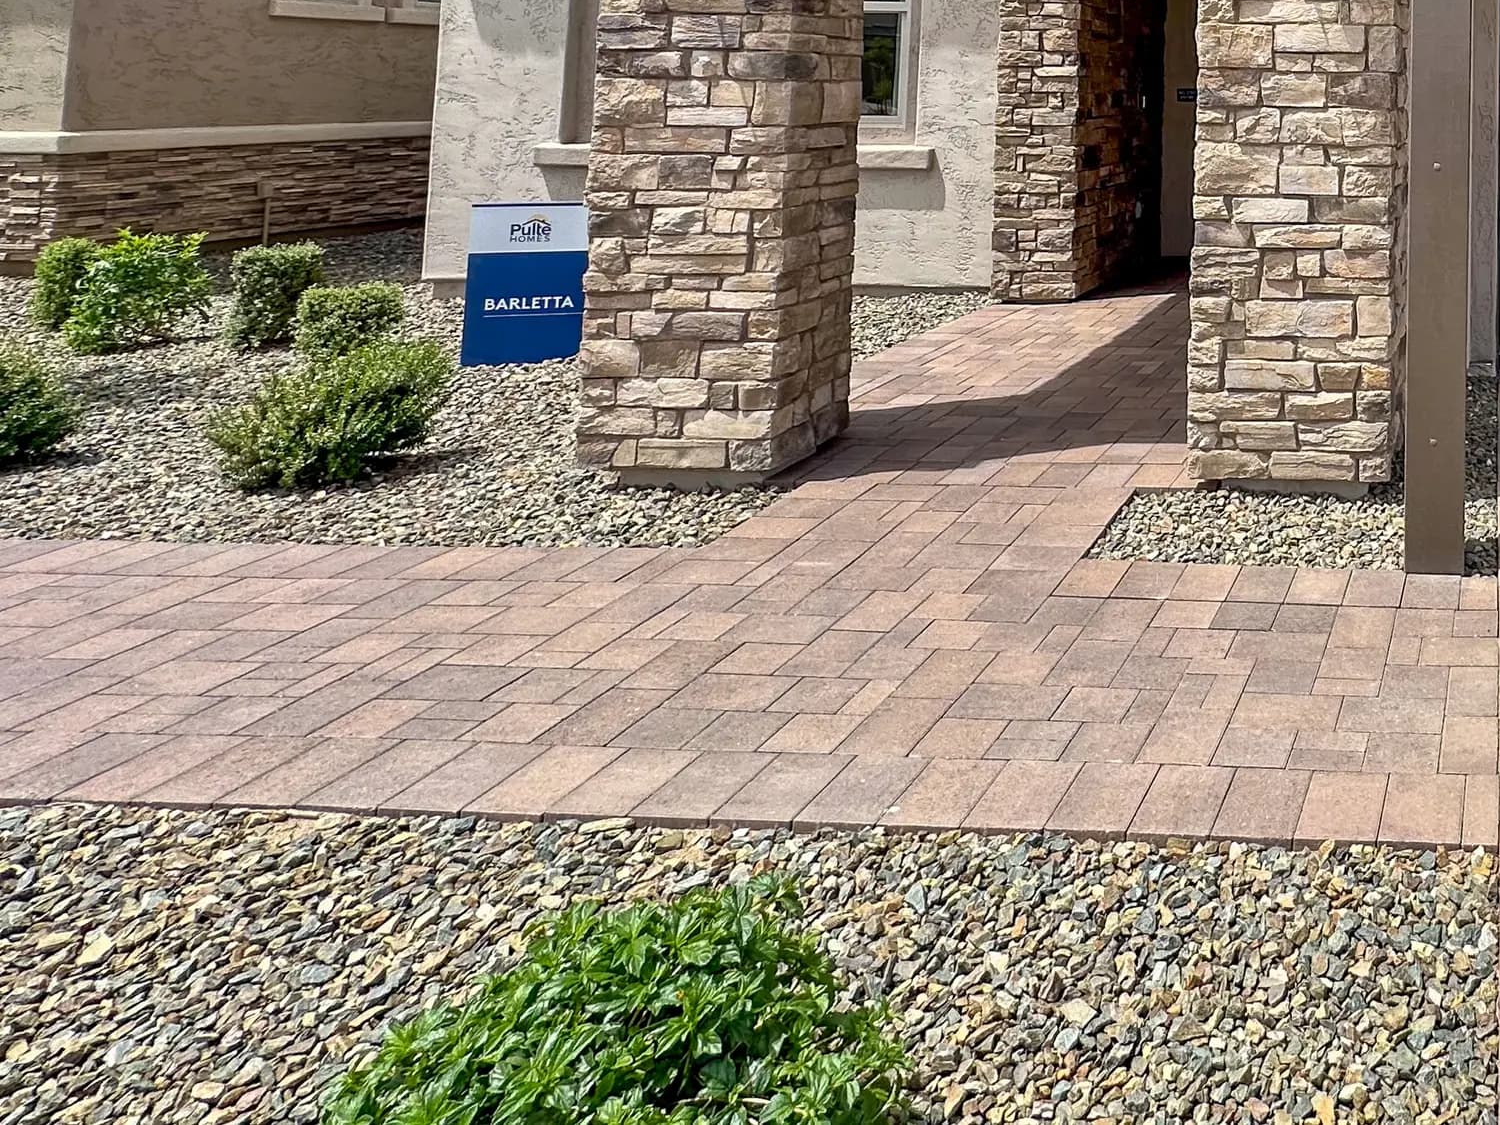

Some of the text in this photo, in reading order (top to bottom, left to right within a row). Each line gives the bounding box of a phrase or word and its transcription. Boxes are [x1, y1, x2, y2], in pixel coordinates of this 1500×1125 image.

[510, 221, 552, 236] Pulte
[509, 235, 551, 243] HOMES
[484, 296, 575, 311] BARLETTA
